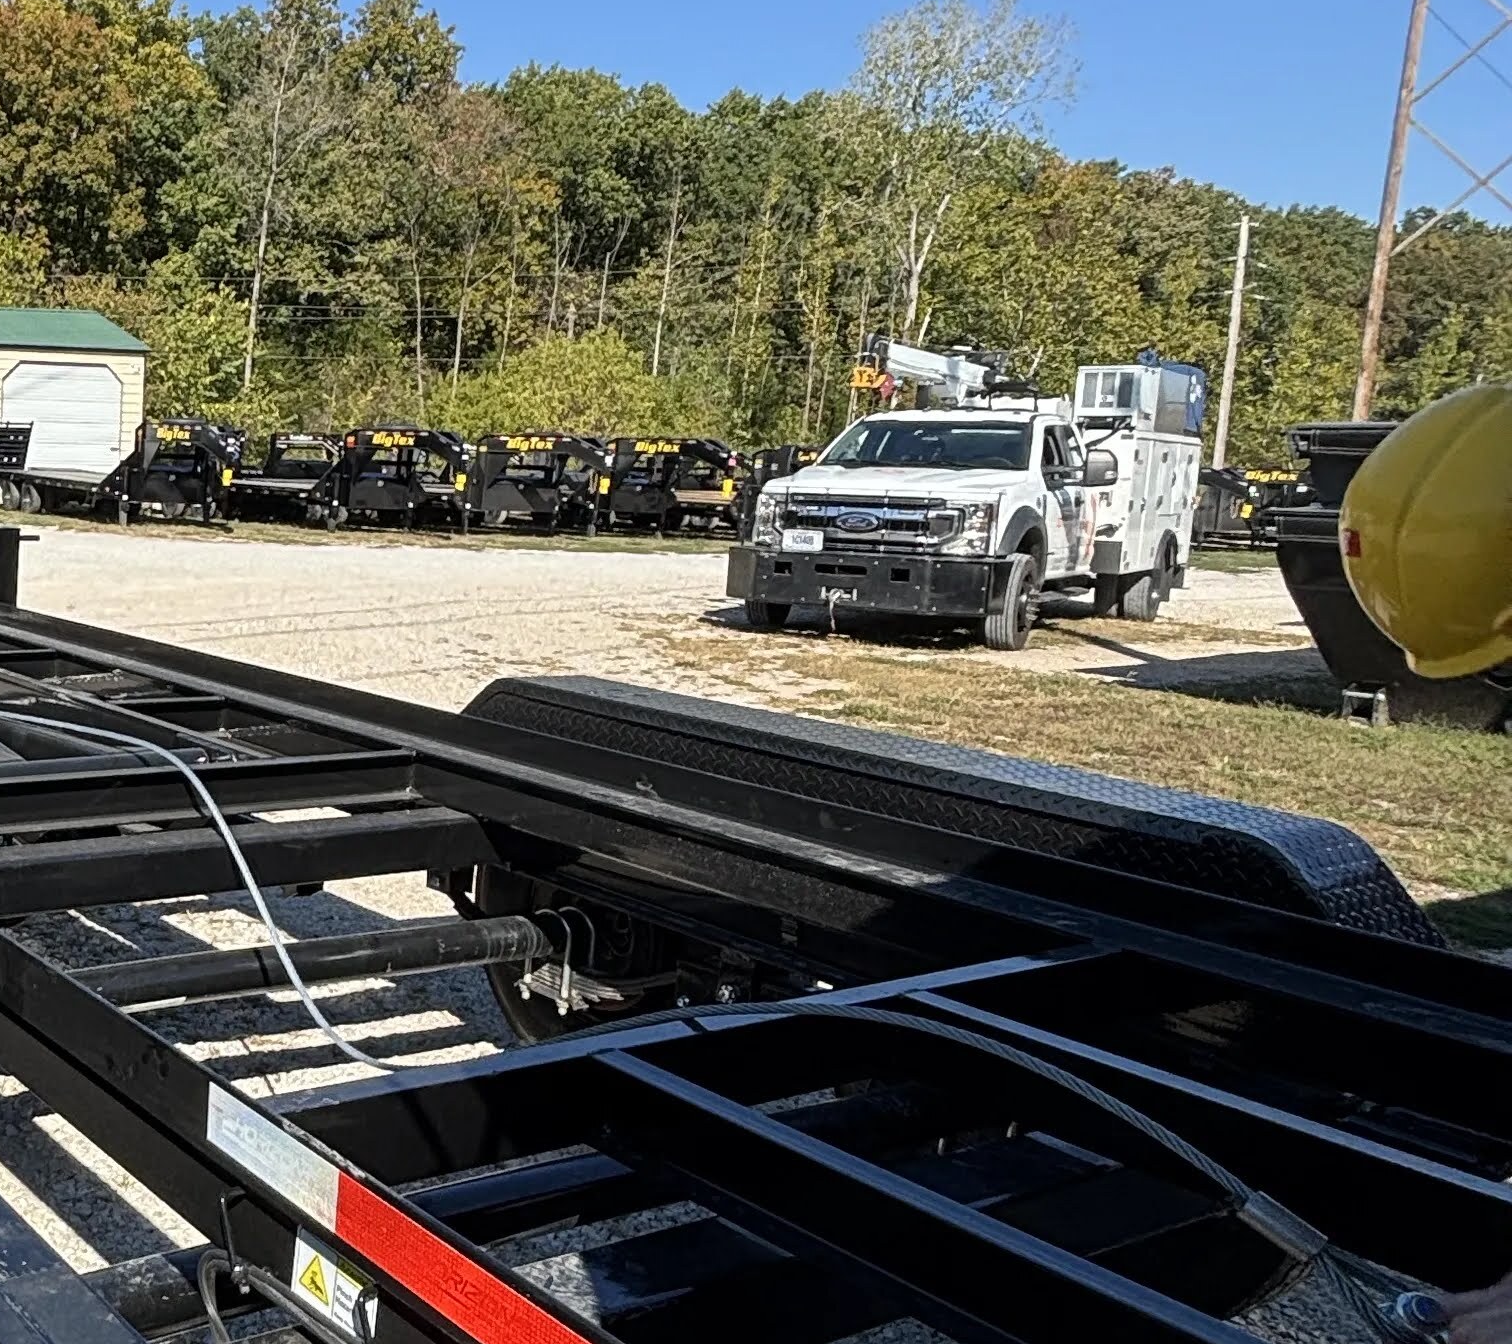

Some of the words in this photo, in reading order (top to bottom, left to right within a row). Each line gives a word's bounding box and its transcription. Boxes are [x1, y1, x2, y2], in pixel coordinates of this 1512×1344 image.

[156, 428, 190, 441] BigTex
[372, 432, 415, 447] BigTex
[506, 437, 555, 451] BigTex
[634, 441, 681, 454] BigTex
[1244, 470, 1299, 483] BigTex
